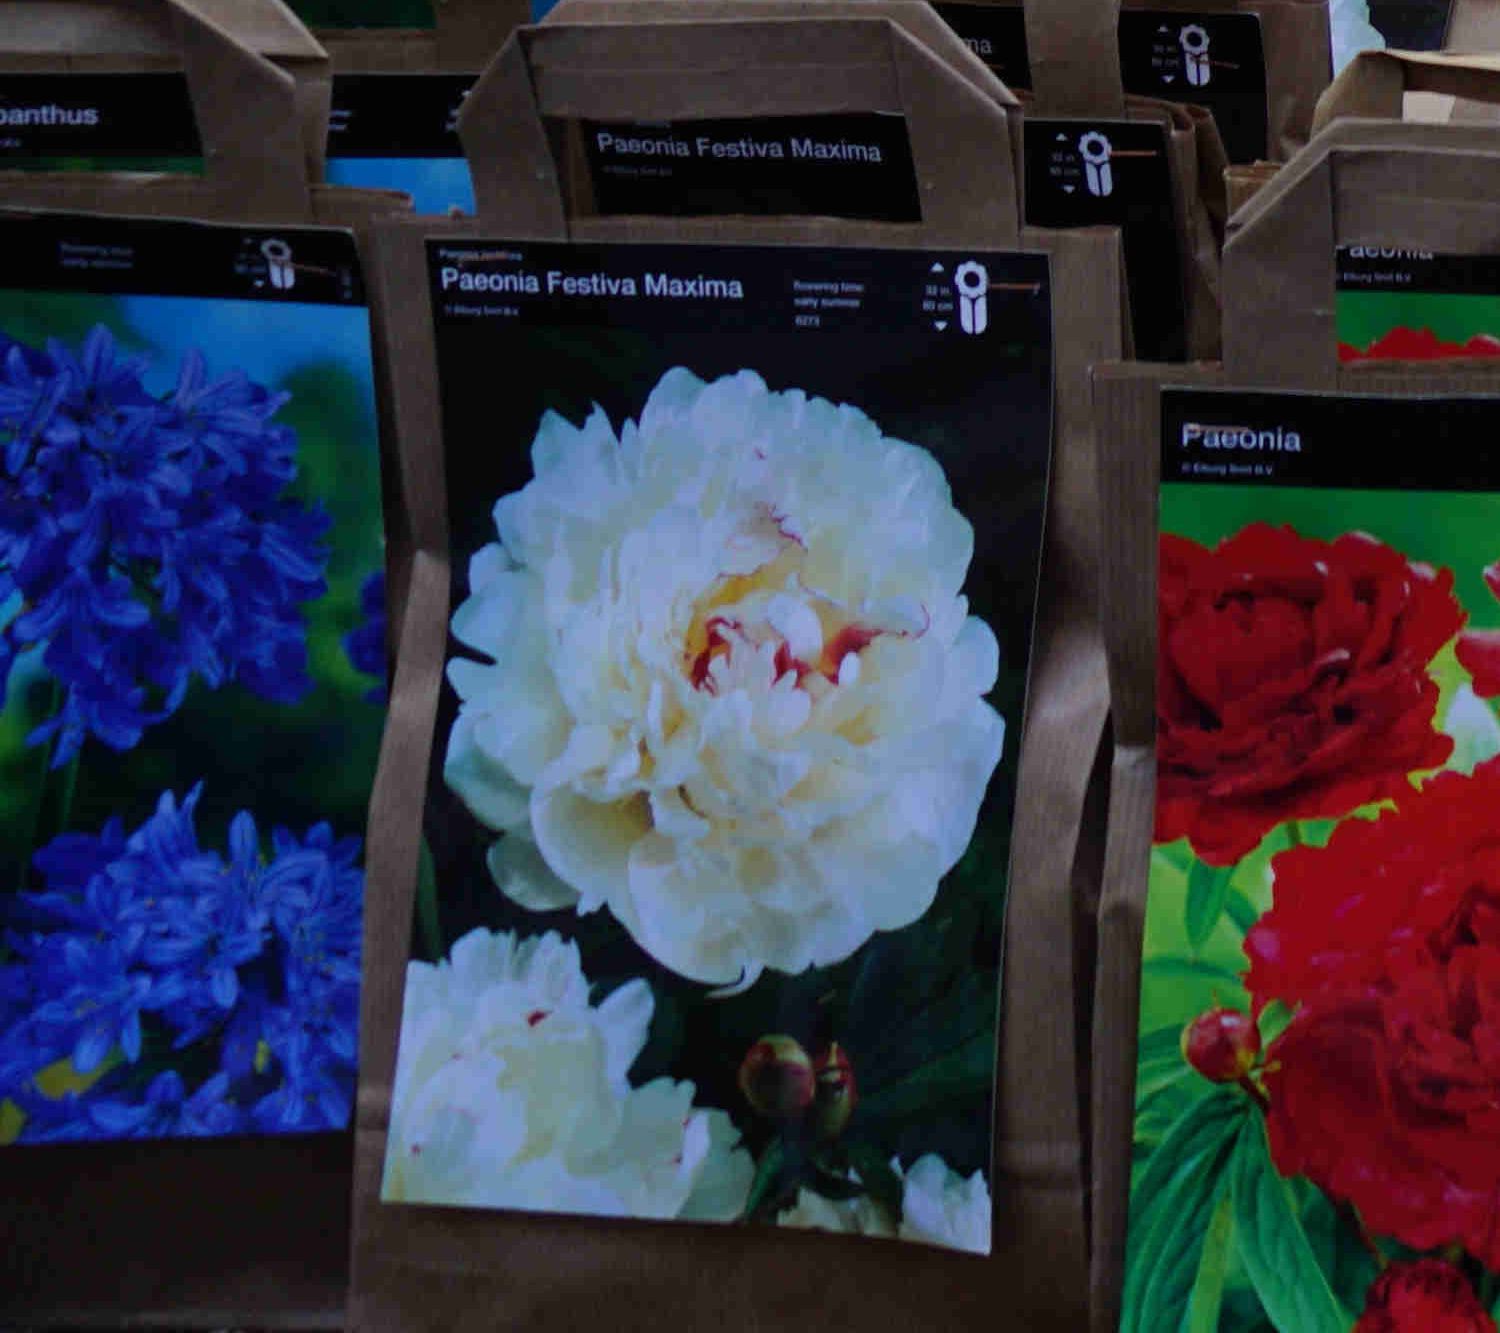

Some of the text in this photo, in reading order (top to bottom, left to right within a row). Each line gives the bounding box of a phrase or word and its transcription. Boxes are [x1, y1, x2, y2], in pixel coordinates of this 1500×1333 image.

[596, 131, 884, 163] Paeonia Festiva Maxima
[440, 266, 746, 302] Paeonia Festiva Maxima
[1181, 422, 1303, 452] Paeonia
